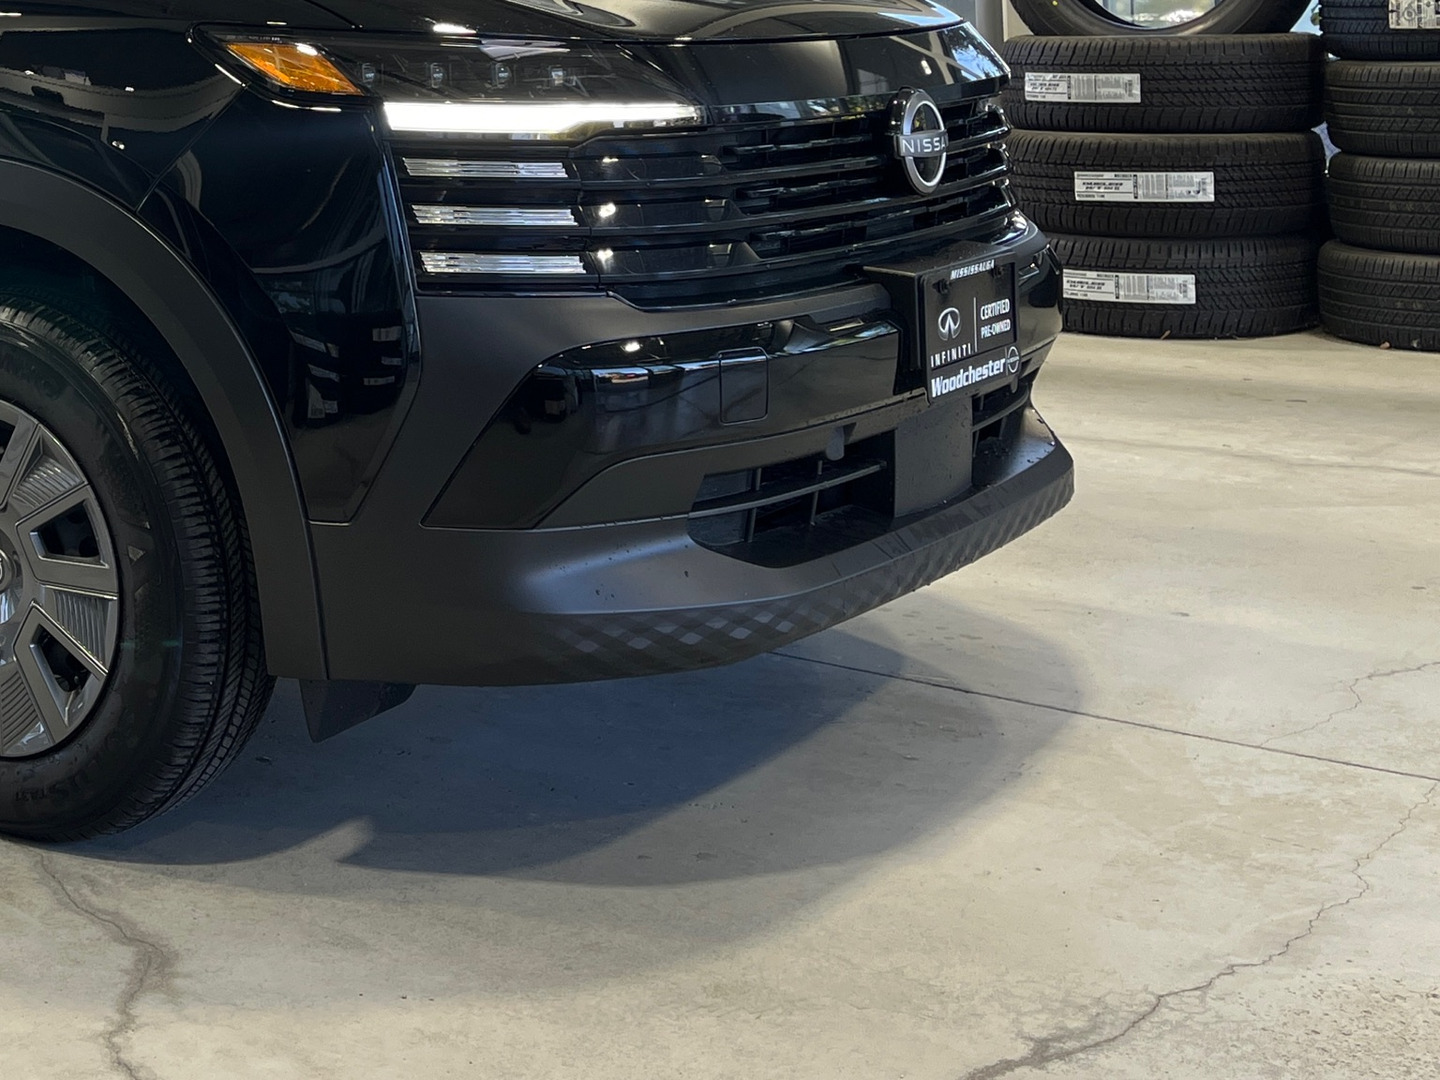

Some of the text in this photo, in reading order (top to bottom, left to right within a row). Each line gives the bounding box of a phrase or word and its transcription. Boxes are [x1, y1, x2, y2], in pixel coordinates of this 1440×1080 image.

[902, 137, 946, 153] NISSA
[980, 298, 1010, 320] CERTIFIED
[981, 319, 1011, 339] PRE-OWNED
[930, 342, 971, 368] INFINITI
[931, 358, 1006, 398] Woodchester
